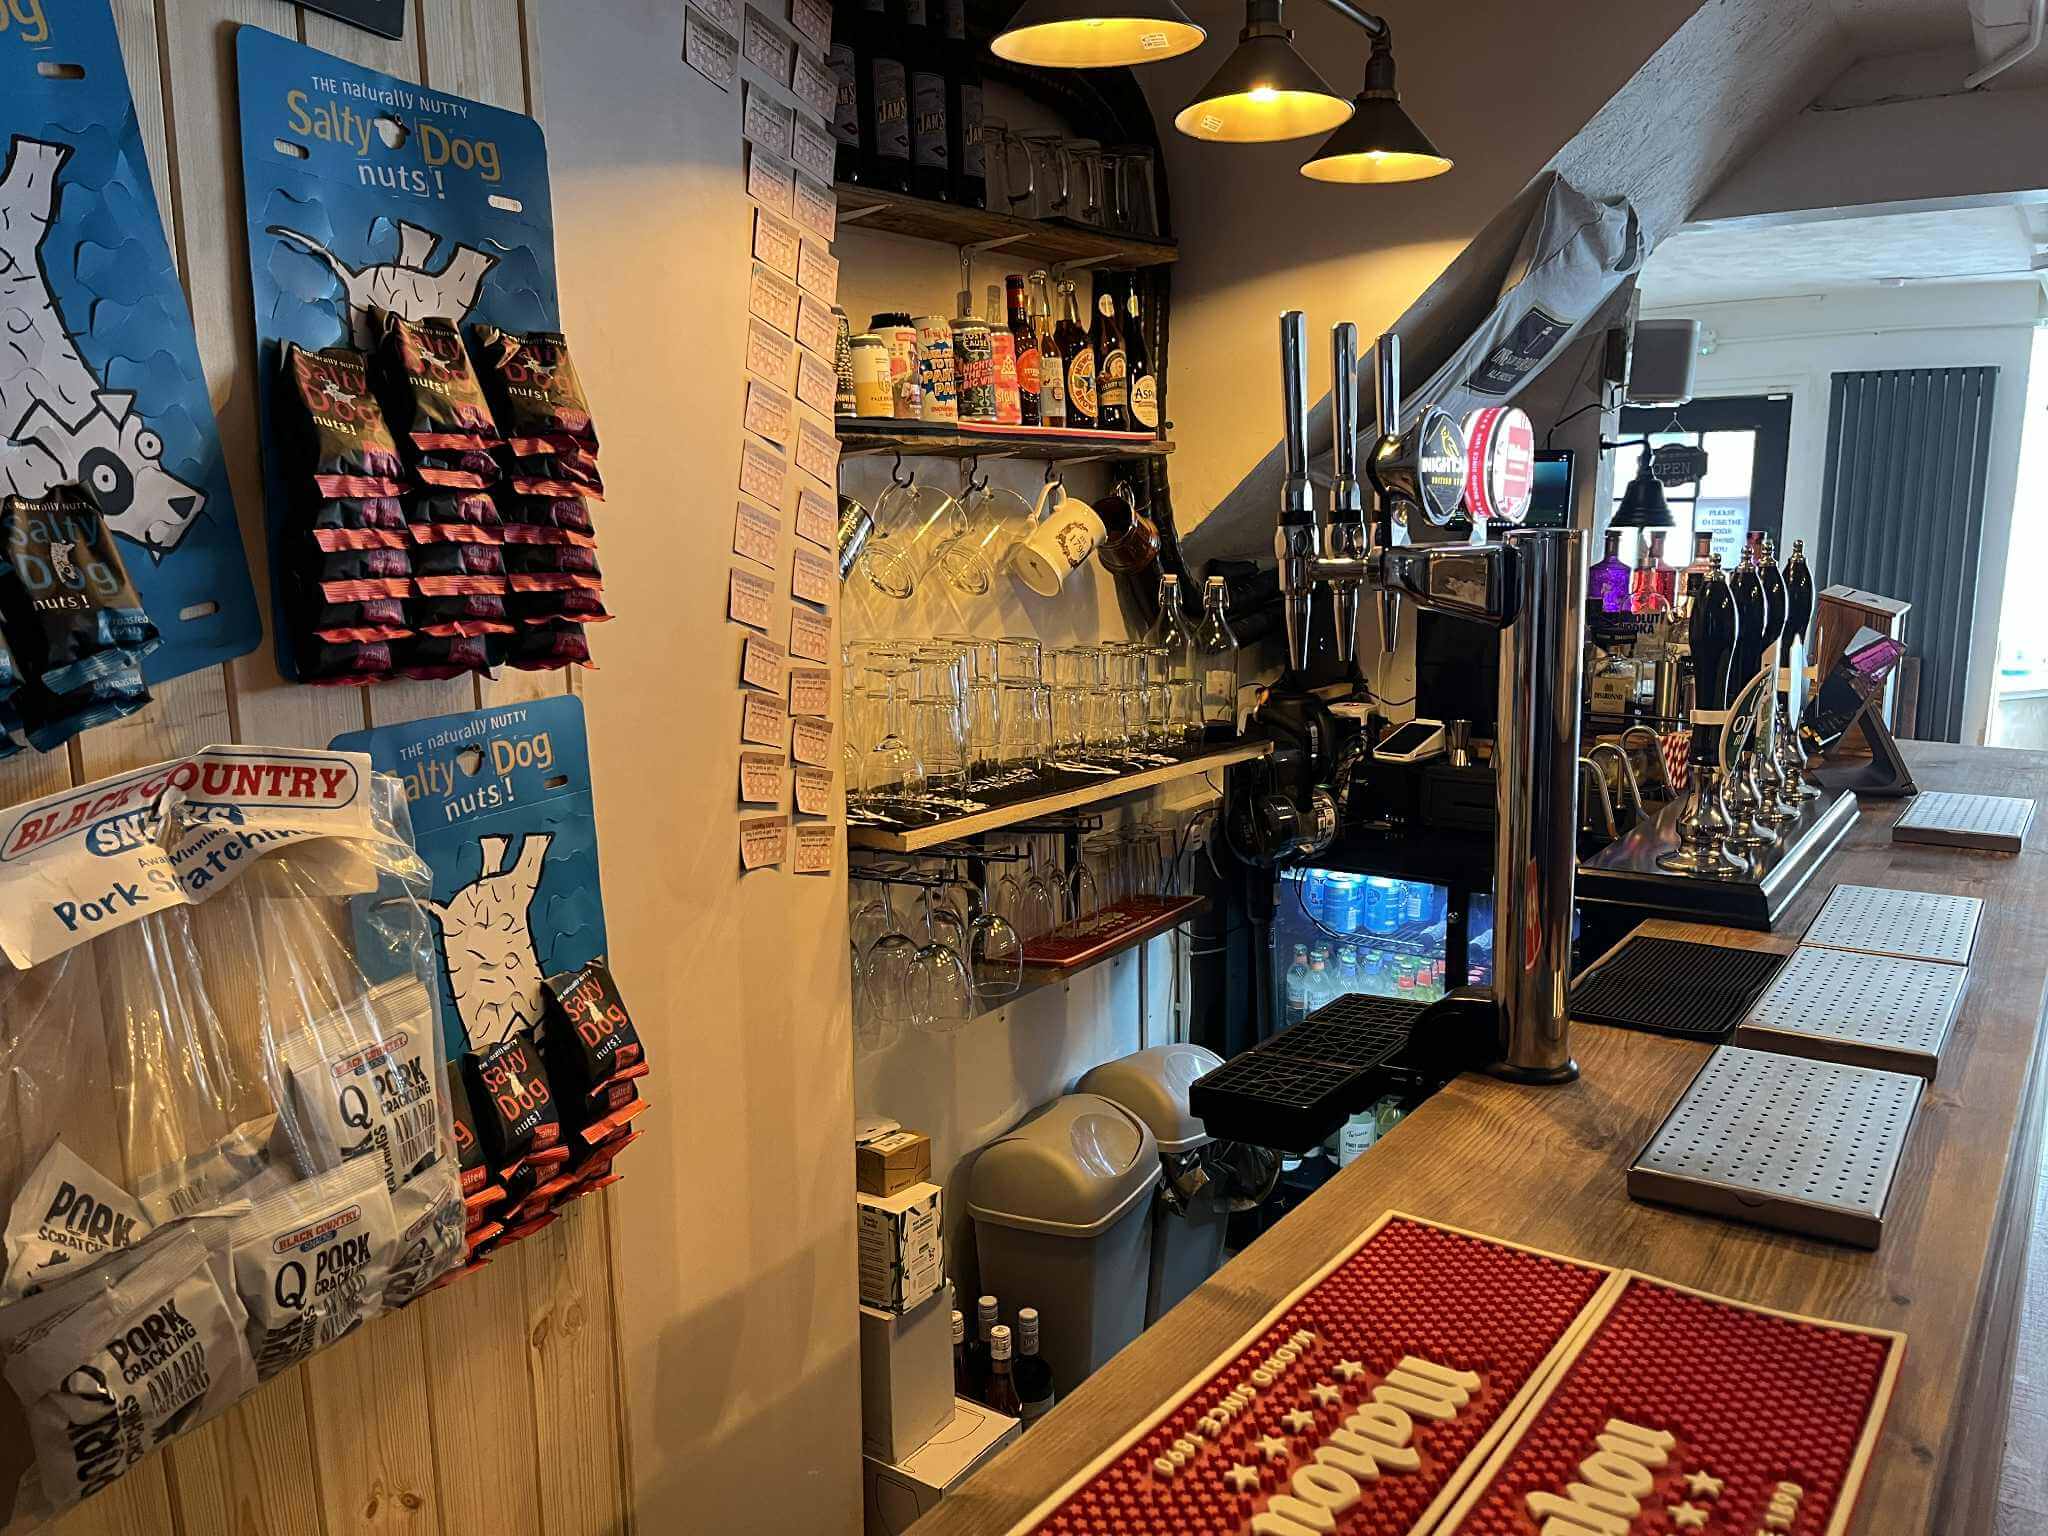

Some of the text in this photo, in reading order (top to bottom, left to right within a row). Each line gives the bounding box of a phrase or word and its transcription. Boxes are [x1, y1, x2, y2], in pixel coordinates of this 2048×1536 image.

[312, 76, 469, 120] THE naturally NUTTY
[287, 89, 500, 181] Salty Dog
[17, 553, 119, 596] Dog
[33, 594, 91, 612] nuts!
[400, 710, 529, 761] THE naturally NUTTY
[490, 731, 554, 778] Dog
[10, 762, 348, 853] BLACK COUNTRY
[53, 880, 150, 931] Pork
[563, 977, 605, 1022] Salty
[578, 1003, 628, 1049] Dog
[596, 1034, 622, 1061] nuts!
[373, 1056, 429, 1098] PORK
[482, 1048, 528, 1094] Salty
[339, 1084, 374, 1130] Q
[497, 1078, 550, 1121] Dog
[514, 1110, 542, 1136] nuts!
[43, 1180, 138, 1250] PORK
[315, 1231, 373, 1279] PORK
[274, 1260, 308, 1311] Q
[106, 1297, 189, 1371] PORK
[122, 1318, 198, 1387] CRACKLING
[1153, 1328, 1317, 1479] MADRID SINCE 1890
[1250, 1354, 1482, 1536] Mahou
[1764, 1480, 1804, 1530] 1890
